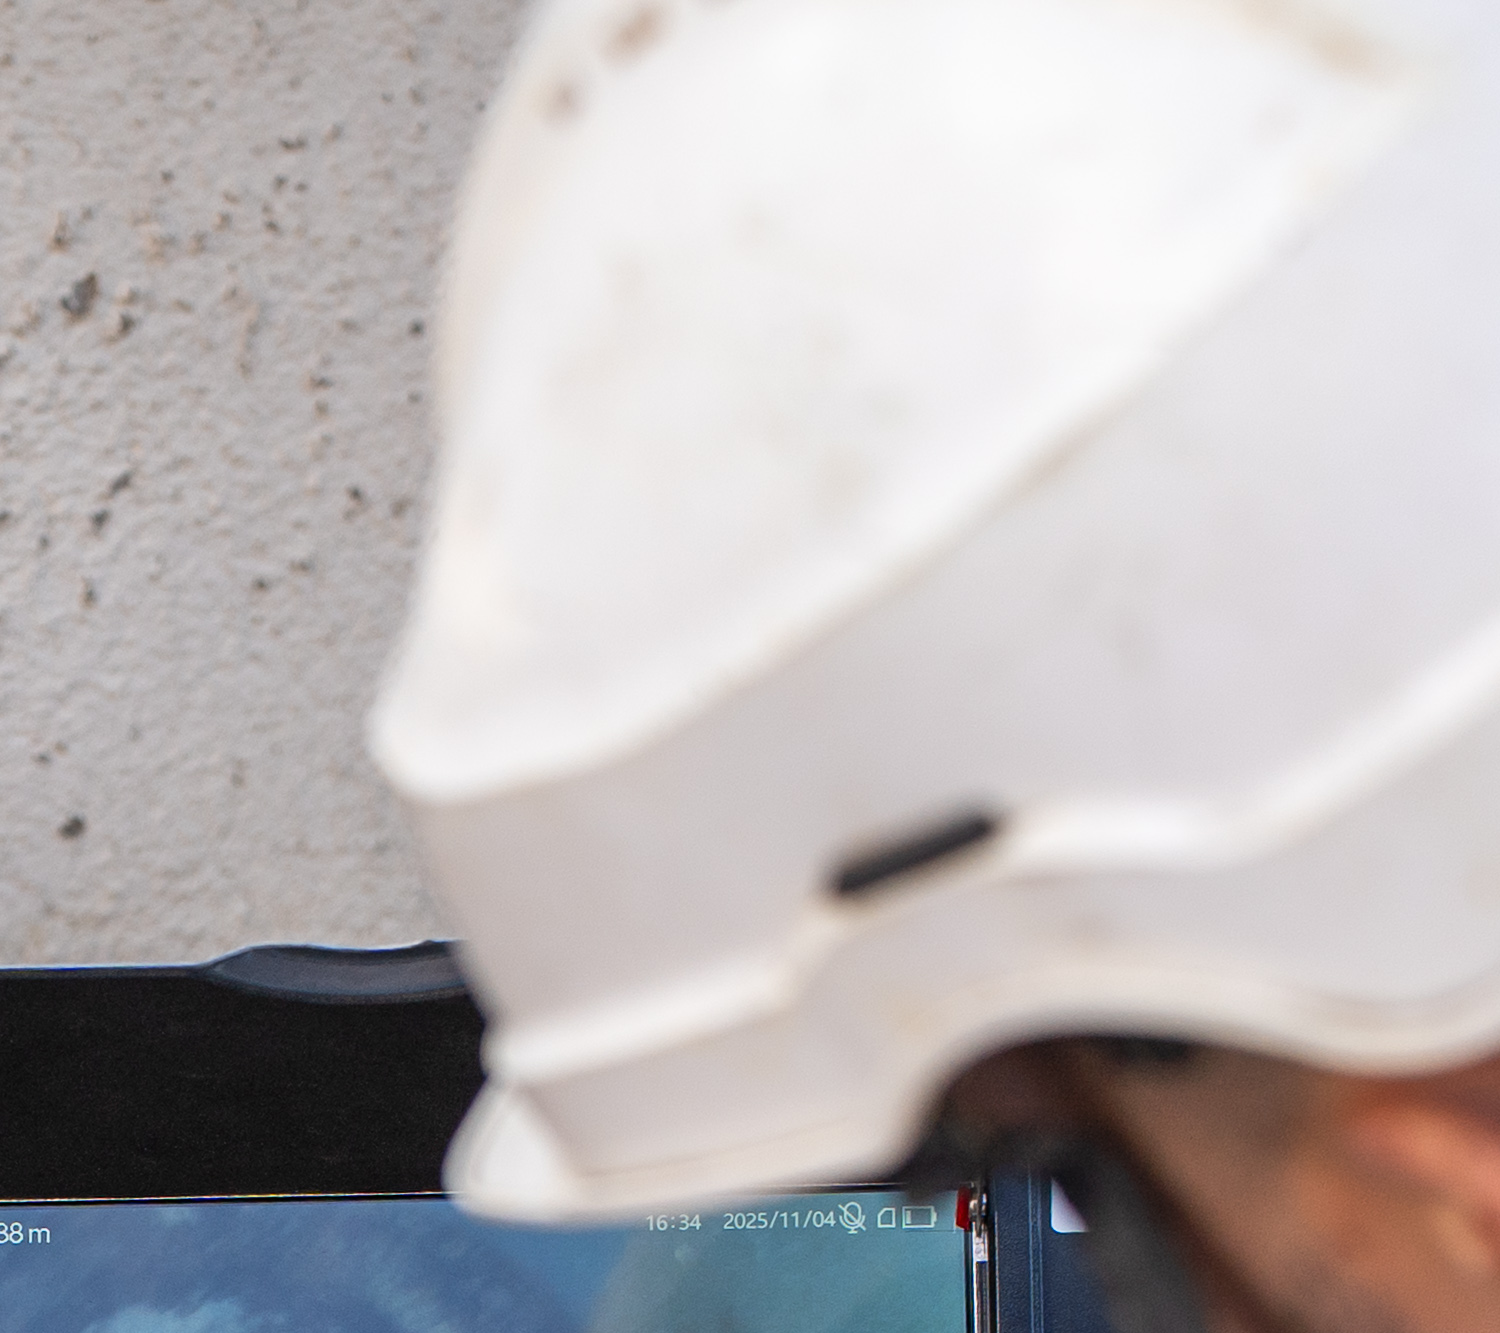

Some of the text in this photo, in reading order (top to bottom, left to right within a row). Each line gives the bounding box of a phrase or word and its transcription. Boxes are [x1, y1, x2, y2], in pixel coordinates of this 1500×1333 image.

[646, 1210, 836, 1231] 16:34 2025/11/04
[28, 1227, 51, 1244] m
